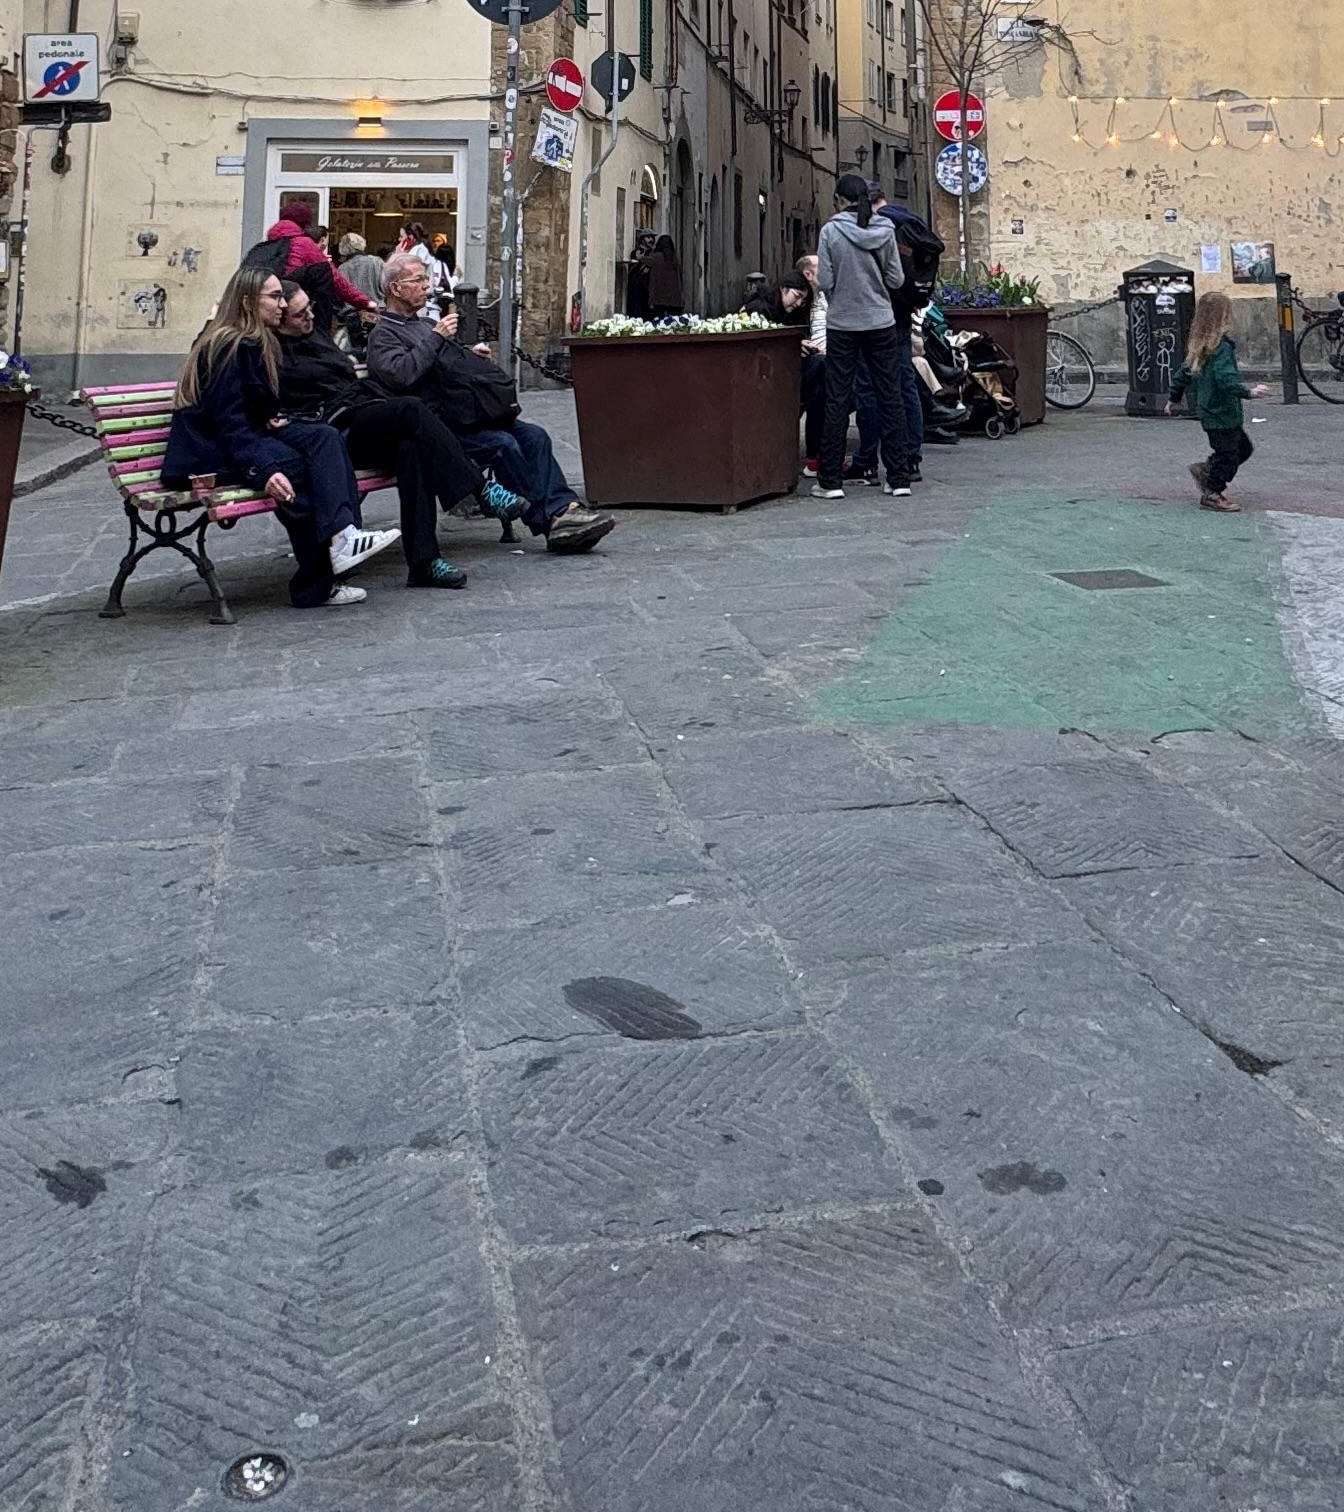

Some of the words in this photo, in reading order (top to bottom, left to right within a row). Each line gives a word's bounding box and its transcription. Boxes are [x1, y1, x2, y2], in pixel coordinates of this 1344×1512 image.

[38, 49, 85, 59] pedonale
[316, 156, 362, 171] Gelateria
[384, 156, 420, 169] Passera
